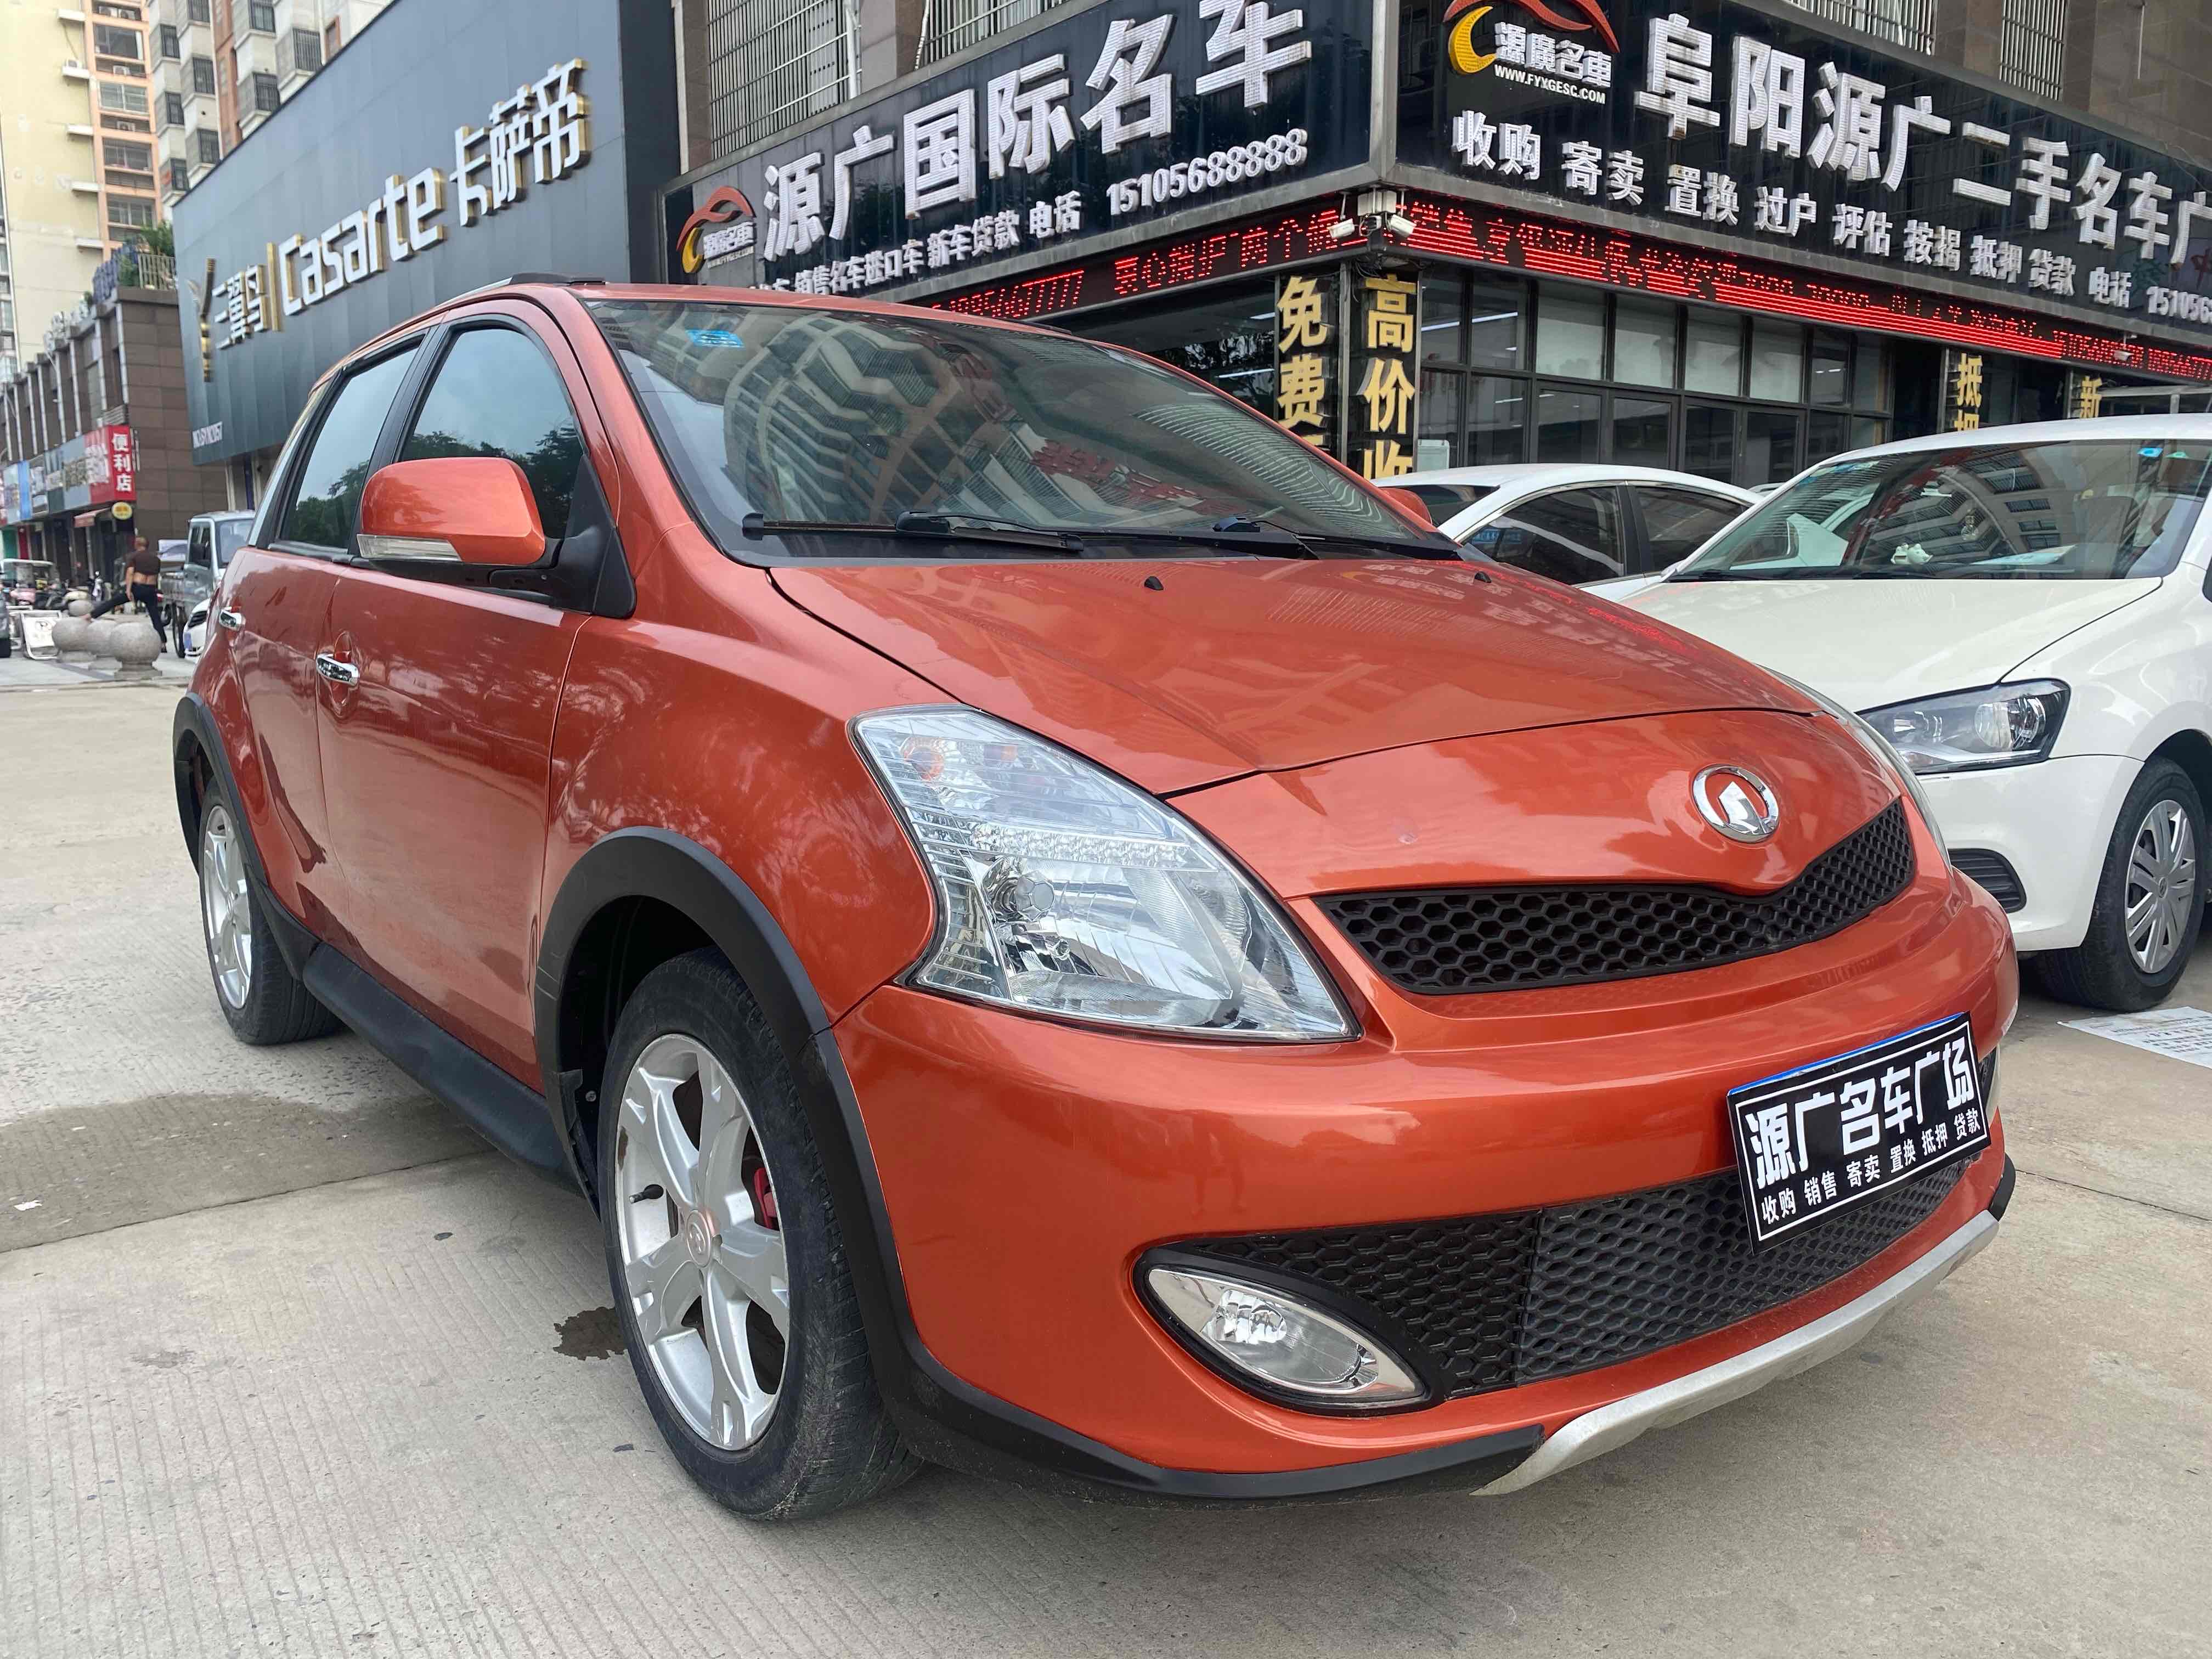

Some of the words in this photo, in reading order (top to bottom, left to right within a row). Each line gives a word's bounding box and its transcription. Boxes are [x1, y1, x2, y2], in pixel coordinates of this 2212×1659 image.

[450, 57, 591, 227] 卡萨帝
[763, 0, 1312, 262] 源广国际名车
[1494, 64, 1606, 104] WWW.FYXGESC.COM
[1634, 13, 2212, 267] 阜阳源广二手名车广
[278, 167, 443, 317] Casarte
[927, 210, 1020, 268] 新车贷款
[1030, 191, 1081, 238] 电话
[1106, 128, 1308, 216] 15105688888
[1452, 110, 1541, 180] 收购
[1562, 140, 1645, 206] 寄卖
[1664, 165, 1740, 225] 置换
[1754, 186, 1817, 237] 过户
[1832, 203, 1893, 257] 评估
[1904, 219, 1961, 271] 按揭
[1970, 235, 2023, 283] 抵押
[2029, 248, 2076, 296] 贷款
[2089, 267, 2132, 308] 电话
[2146, 286, 2212, 324] 151056
[1277, 276, 1328, 445] 免费
[111, 433, 132, 492] 便利店
[1746, 1037, 1974, 1189] 源广名车广场
[1762, 1189, 1796, 1224] 收购
[1804, 1171, 1837, 1207] 销售
[1847, 1155, 1880, 1188] 寄卖
[1890, 1139, 1916, 1173] 置换
[1922, 1122, 1948, 1155] 抵押
[1953, 1108, 1980, 1139] 贷款
